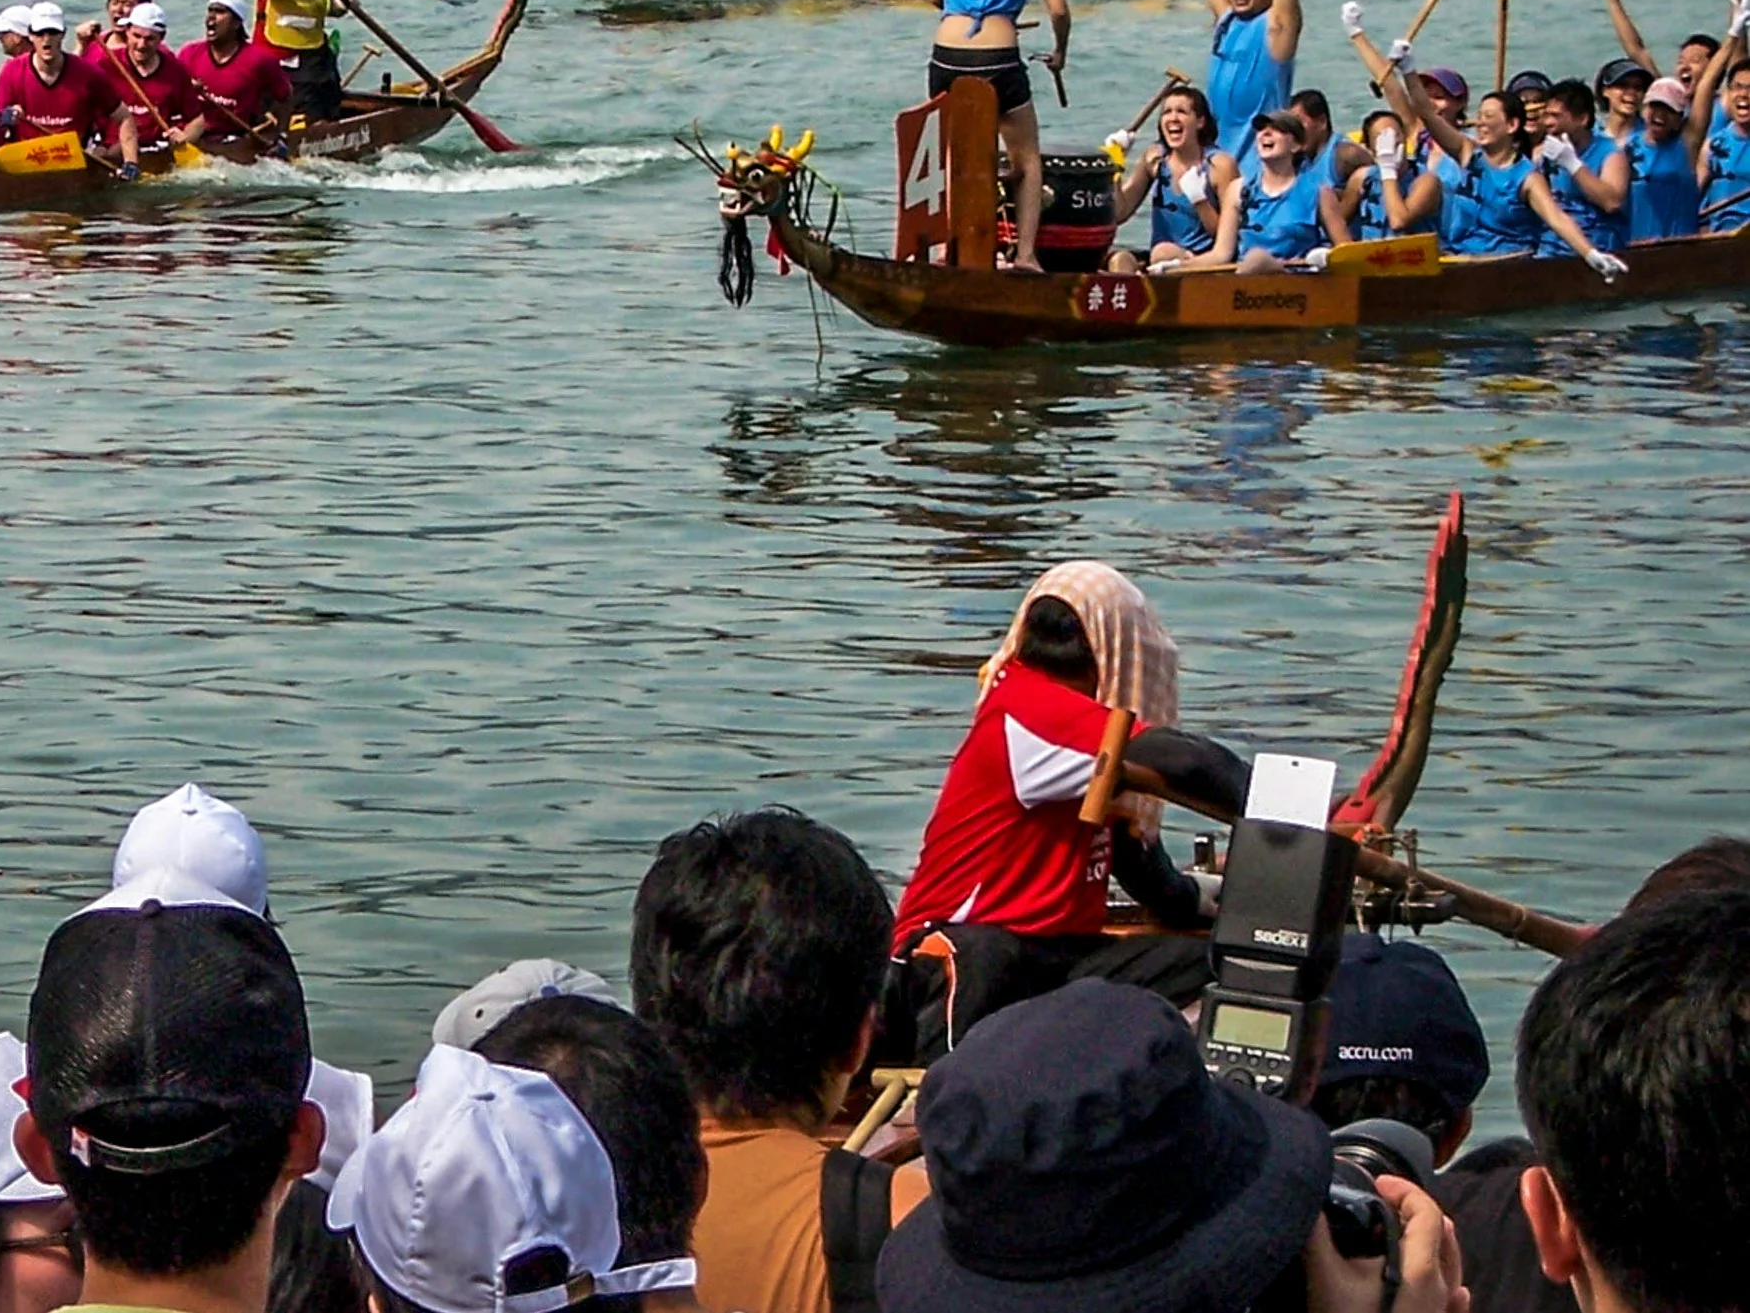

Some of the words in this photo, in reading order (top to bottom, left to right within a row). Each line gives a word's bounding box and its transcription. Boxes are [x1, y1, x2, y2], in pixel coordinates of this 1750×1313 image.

[905, 108, 946, 217] 4
[1233, 289, 1308, 316] Bloomberg
[1338, 1044, 1414, 1061] accru.com
